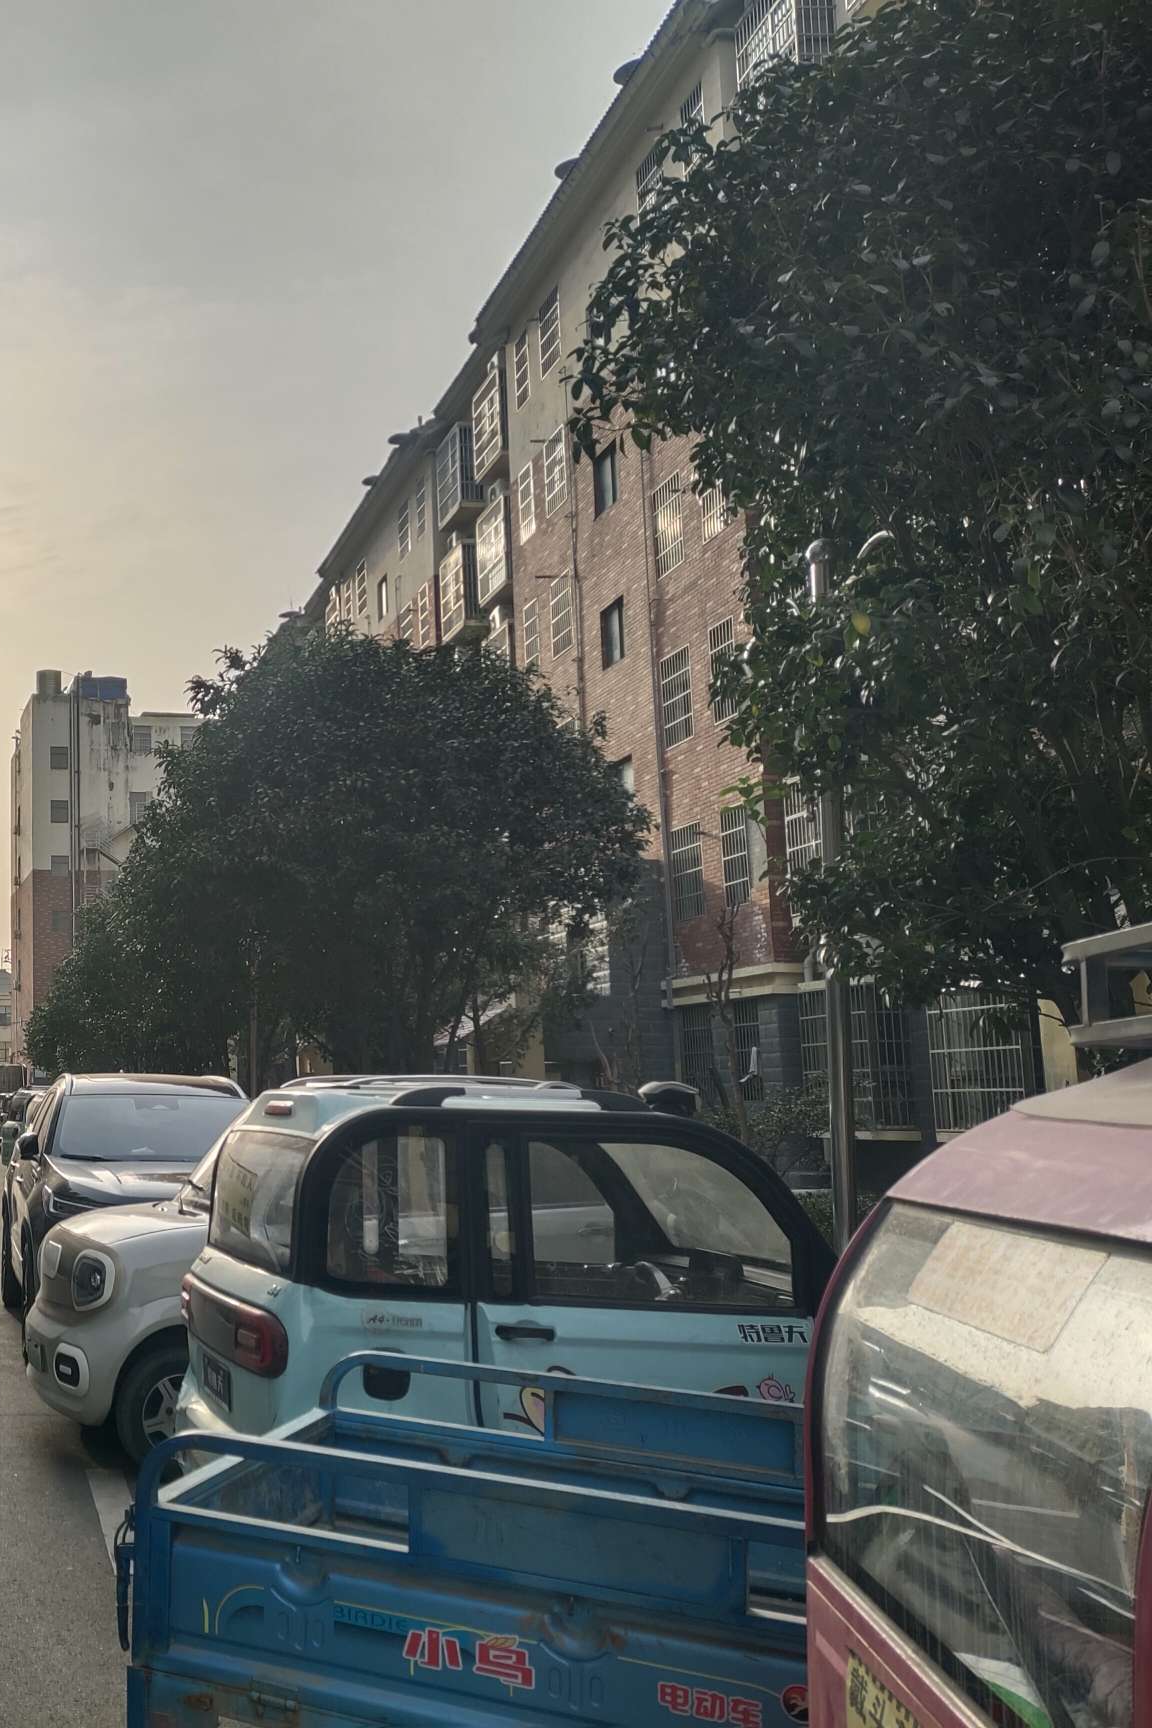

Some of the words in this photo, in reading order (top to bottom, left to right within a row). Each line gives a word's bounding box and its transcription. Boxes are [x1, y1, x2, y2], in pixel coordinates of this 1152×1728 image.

[402, 1627, 536, 1690] 小鸟
[657, 1681, 762, 1728] 电动车
